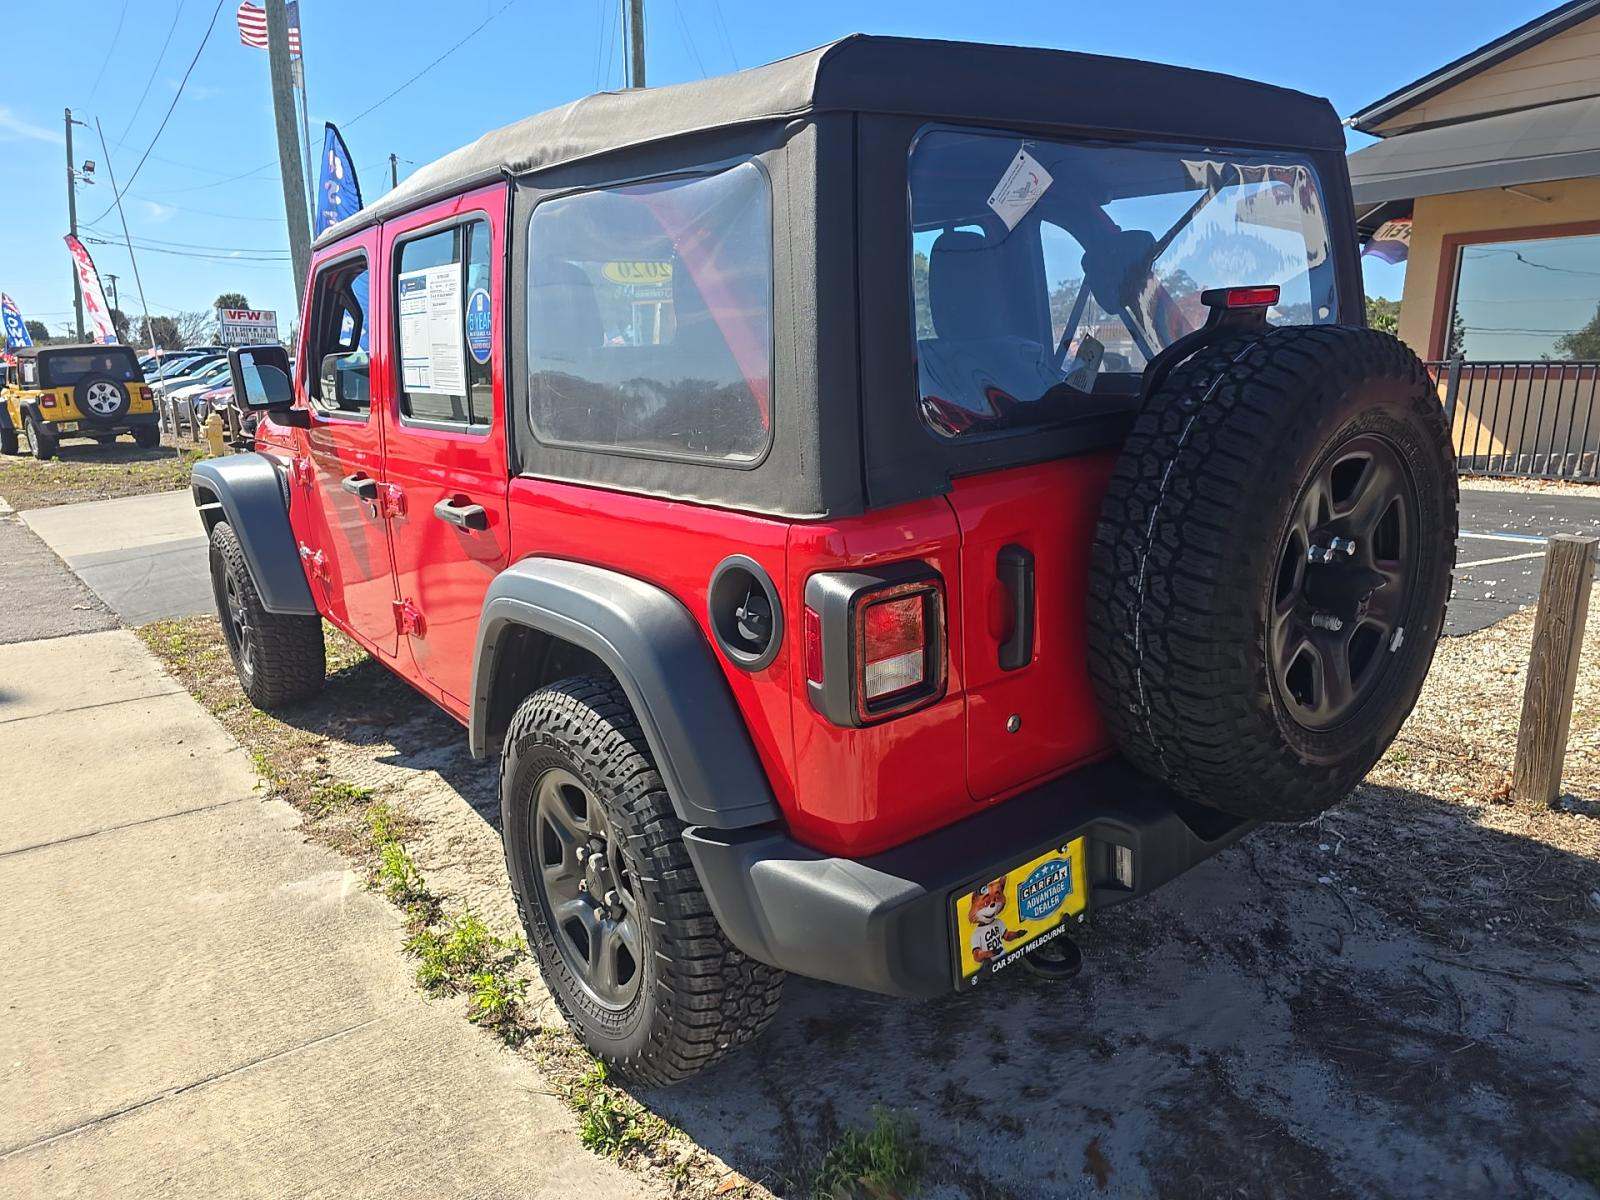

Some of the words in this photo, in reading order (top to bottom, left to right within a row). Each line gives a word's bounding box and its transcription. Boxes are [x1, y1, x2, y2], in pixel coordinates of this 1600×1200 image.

[228, 310, 261, 321] VFW
[1023, 866, 1067, 898] CARFAX
[1027, 882, 1065, 910] ADVANTAGE
[1034, 895, 1060, 917] DEALER
[984, 926, 1000, 942] CAR
[986, 934, 1003, 951] FOX
[992, 959, 1007, 973] CAR
[1007, 949, 1025, 964] SPOT
[1025, 923, 1066, 954] MELBOURNE
